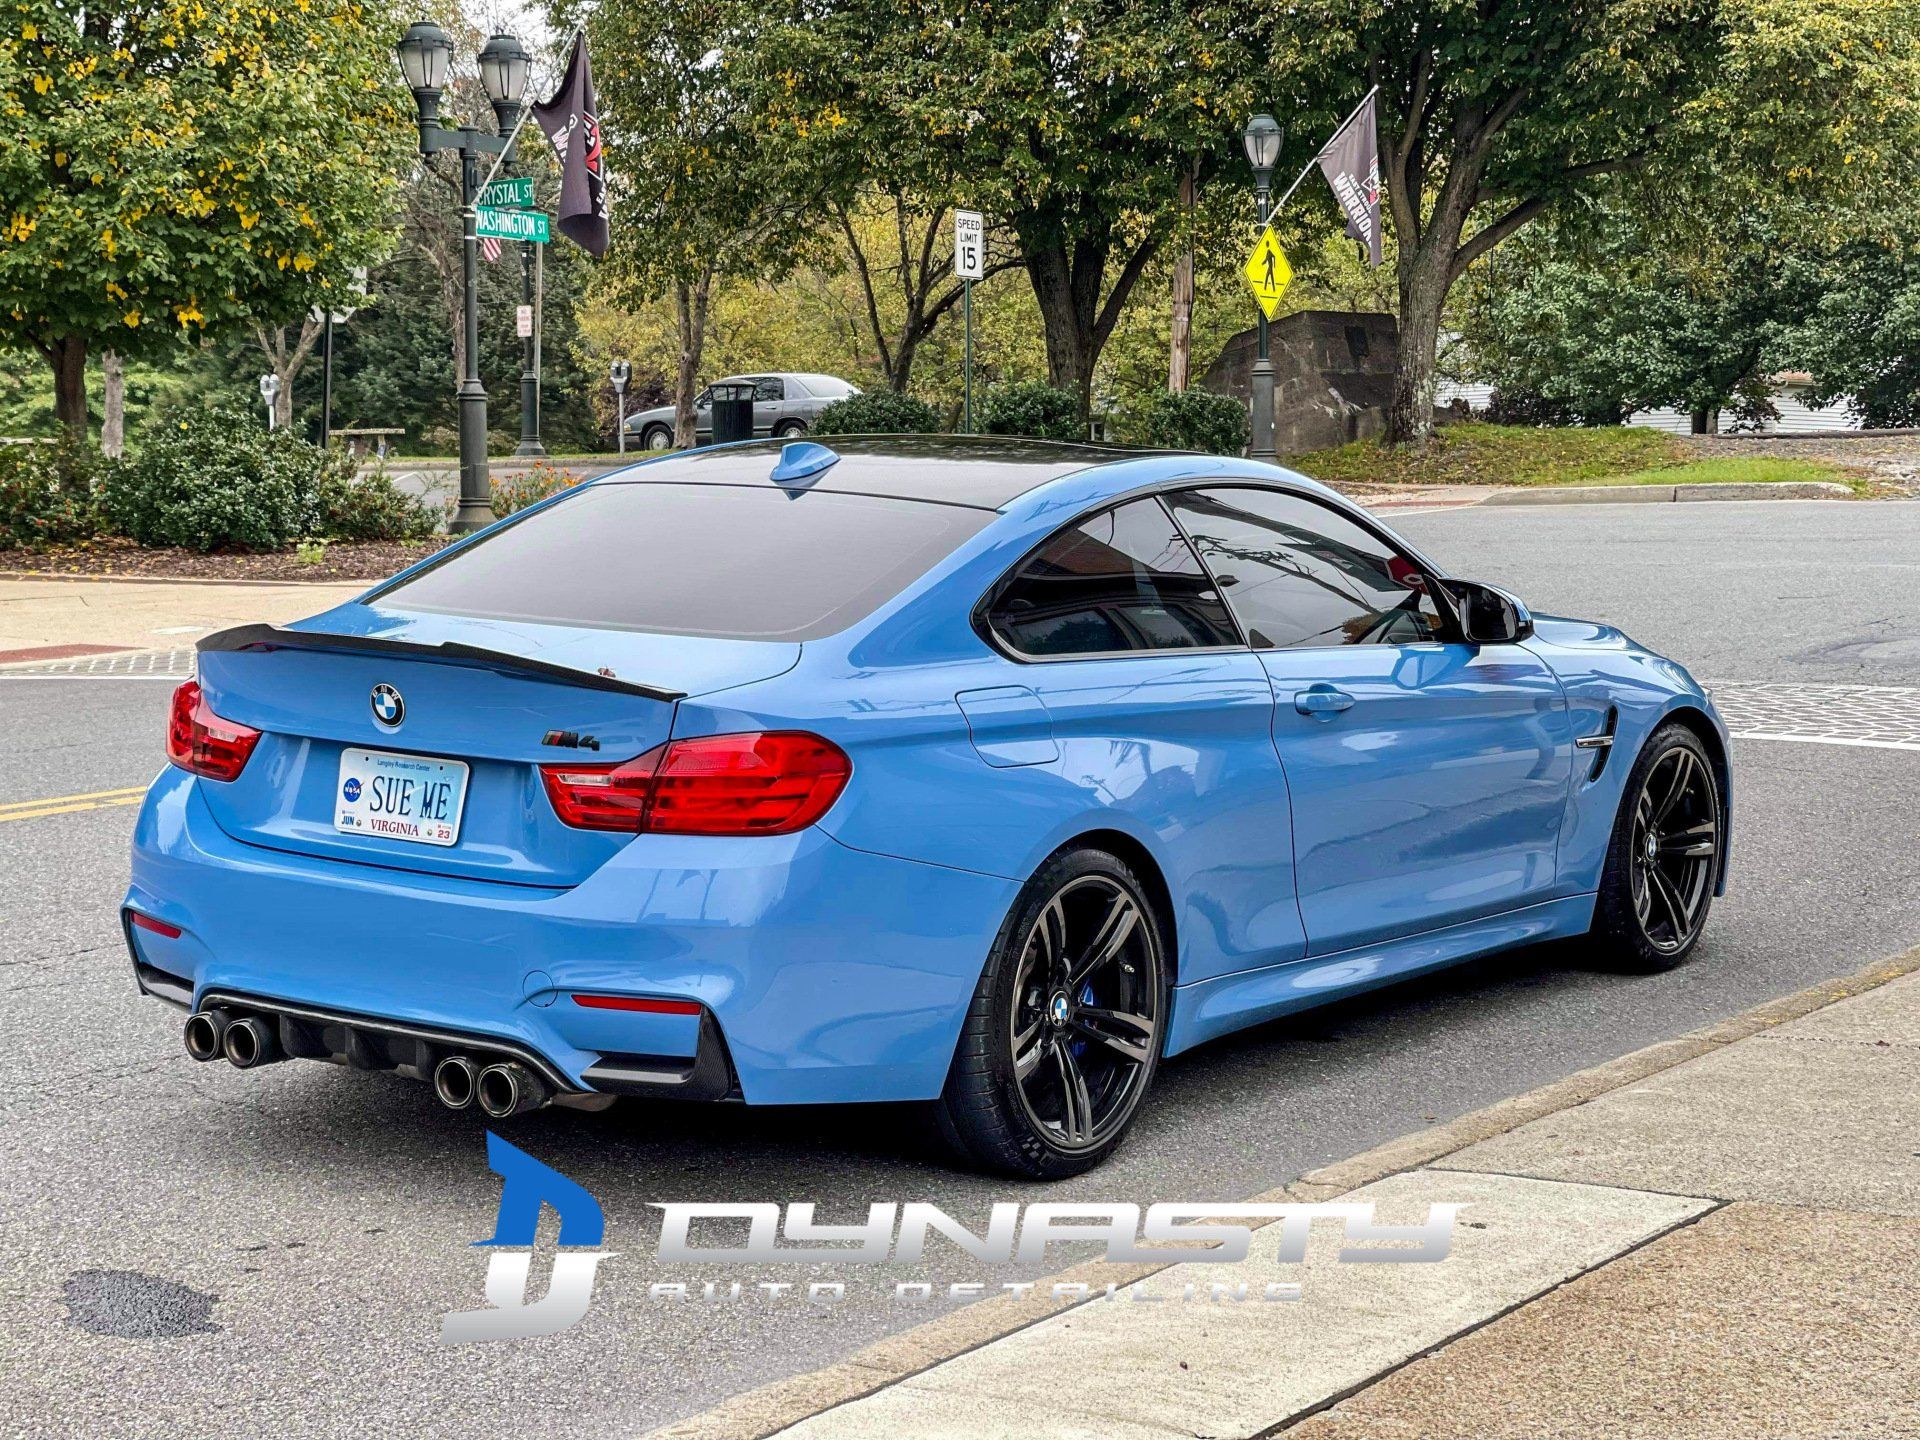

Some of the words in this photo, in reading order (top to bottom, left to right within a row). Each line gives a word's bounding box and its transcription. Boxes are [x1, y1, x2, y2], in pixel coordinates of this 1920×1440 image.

[478, 183, 521, 206] CRYSTAL
[523, 185, 533, 198] ST
[476, 210, 536, 236] WASHINGTON
[537, 220, 546, 234] ST
[958, 219, 980, 231] SPEED
[960, 233, 977, 244] LIMIT
[962, 246, 976, 270] 15
[372, 685, 400, 700] BMW
[370, 775, 415, 816] SUE
[420, 781, 452, 820] ME
[341, 815, 355, 826] JUN
[371, 818, 419, 837] VIRGINIA
[437, 829, 451, 840] 23
